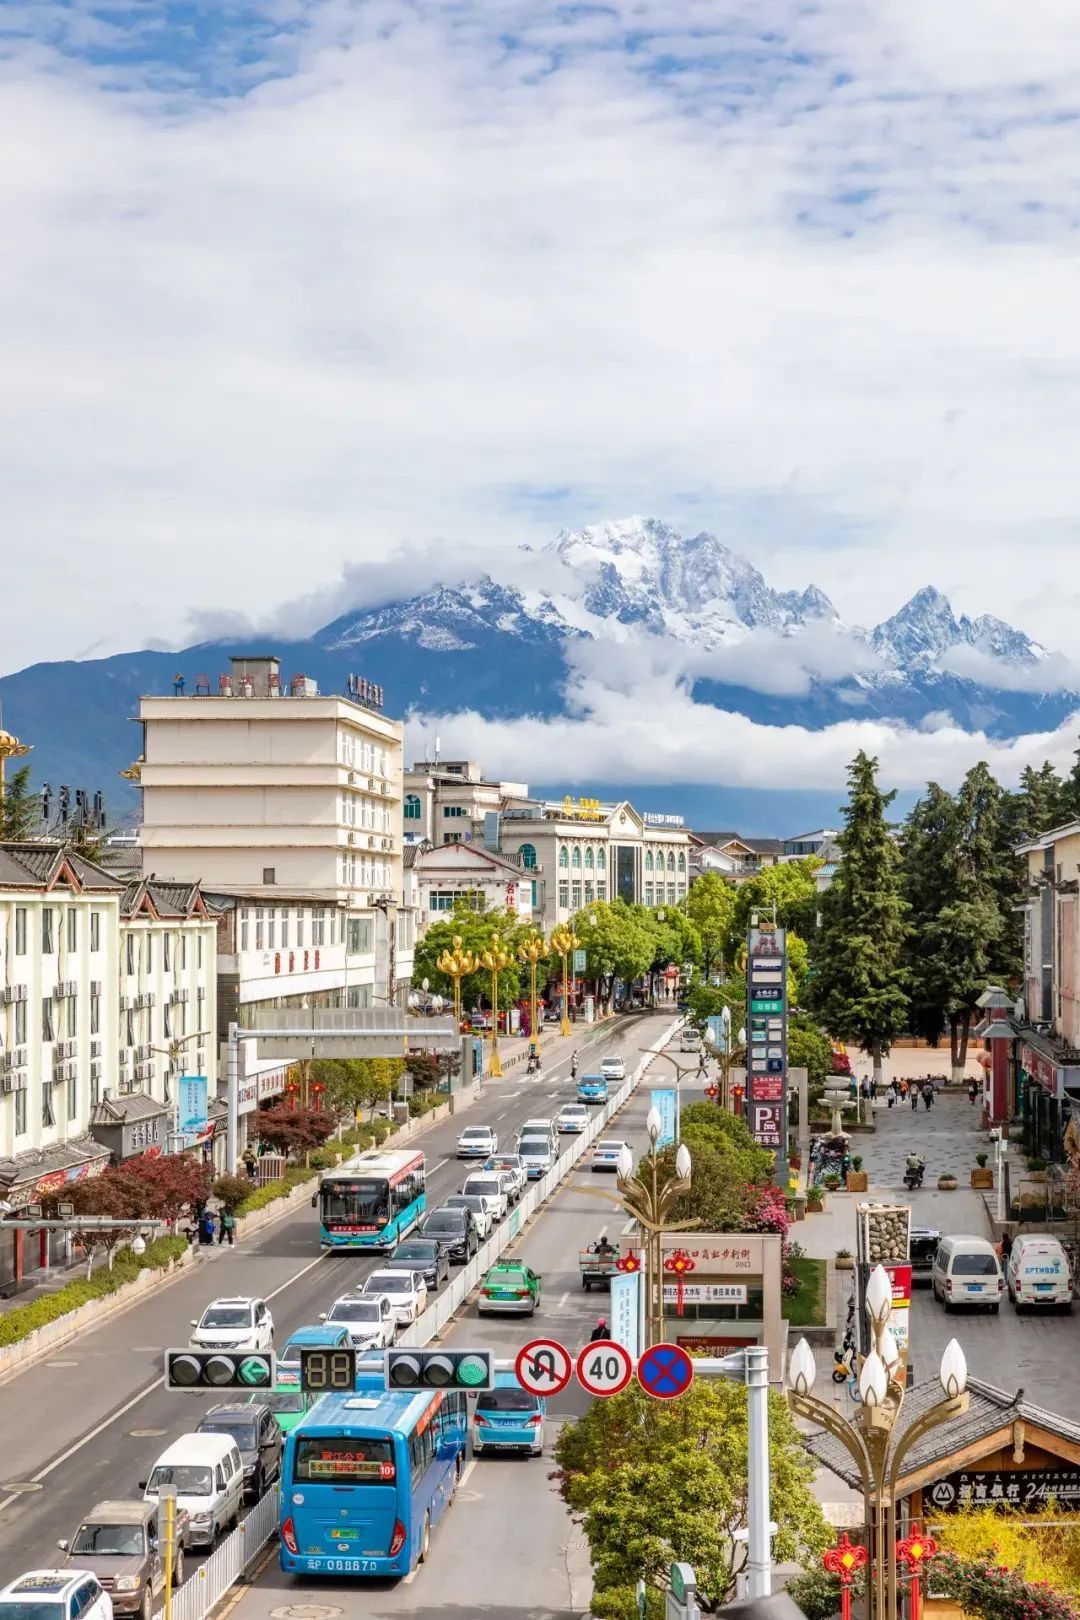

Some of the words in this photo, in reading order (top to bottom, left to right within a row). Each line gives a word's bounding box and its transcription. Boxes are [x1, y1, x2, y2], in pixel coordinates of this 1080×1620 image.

[755, 1107, 772, 1131] P
[754, 1135, 780, 1145] 停车场
[589, 1356, 619, 1381] 40
[321, 1450, 366, 1461] 丽江公交
[380, 1466, 395, 1475] 101
[958, 1483, 1020, 1499] 招商银行
